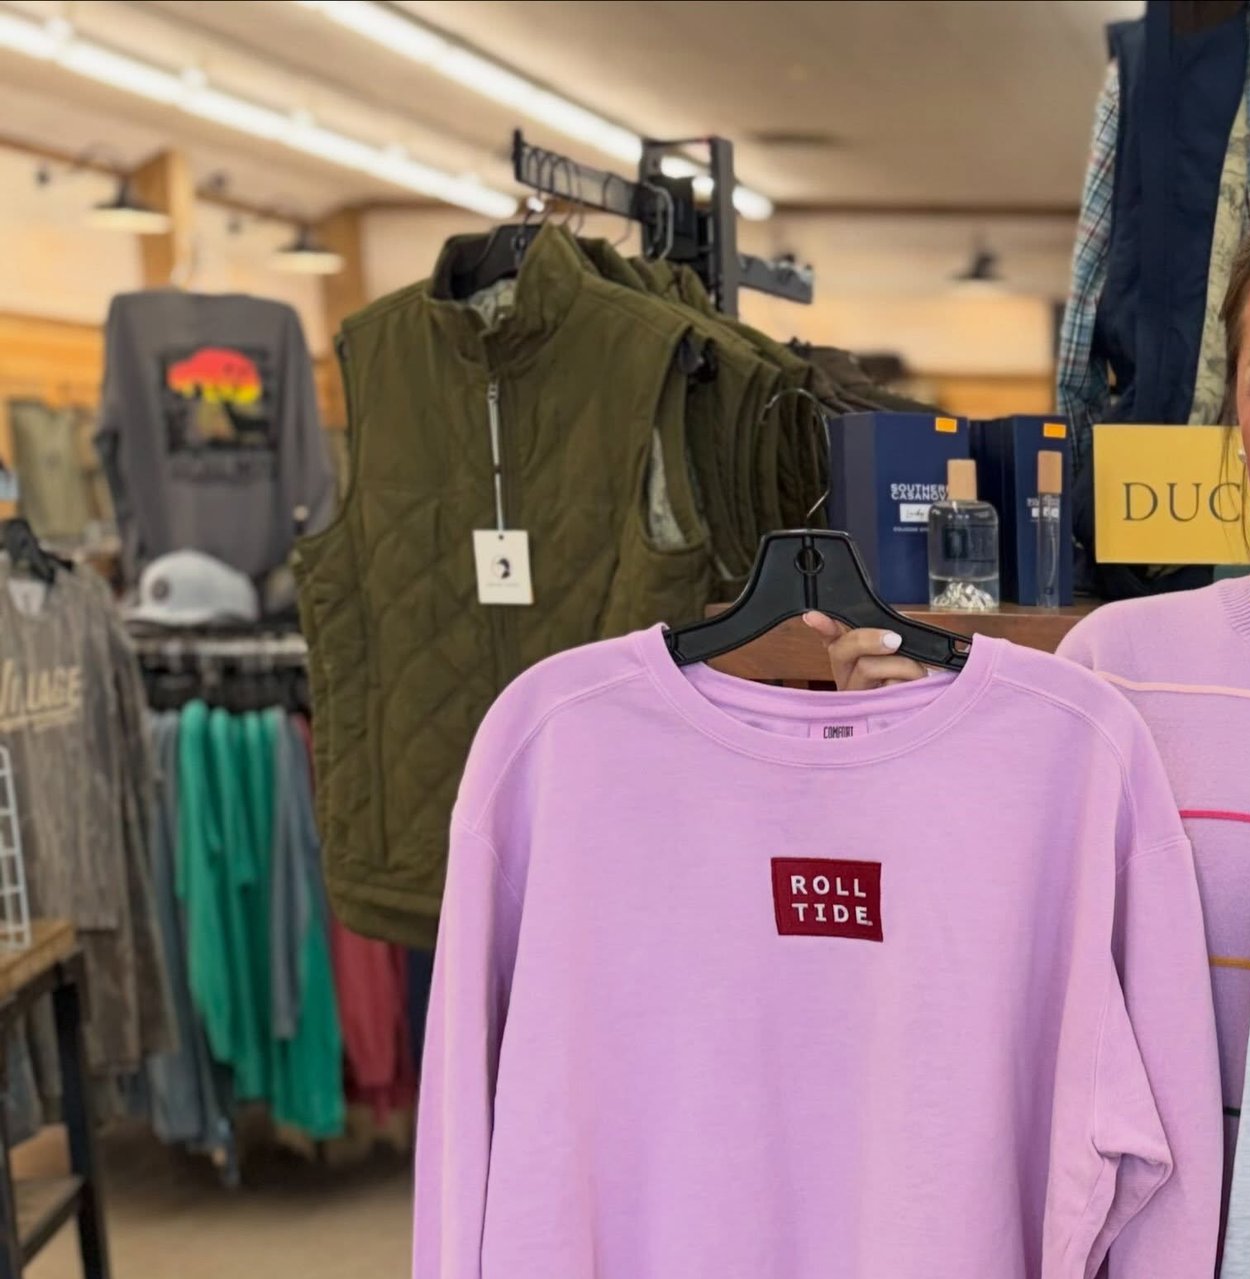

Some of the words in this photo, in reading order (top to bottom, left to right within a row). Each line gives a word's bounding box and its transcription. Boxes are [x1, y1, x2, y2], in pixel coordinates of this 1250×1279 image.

[890, 483, 948, 493] SOUTHER
[891, 491, 947, 500] CASANOV
[823, 726, 854, 739] COMFORT
[790, 875, 867, 898] ROLL
[791, 903, 869, 925] TIDE
